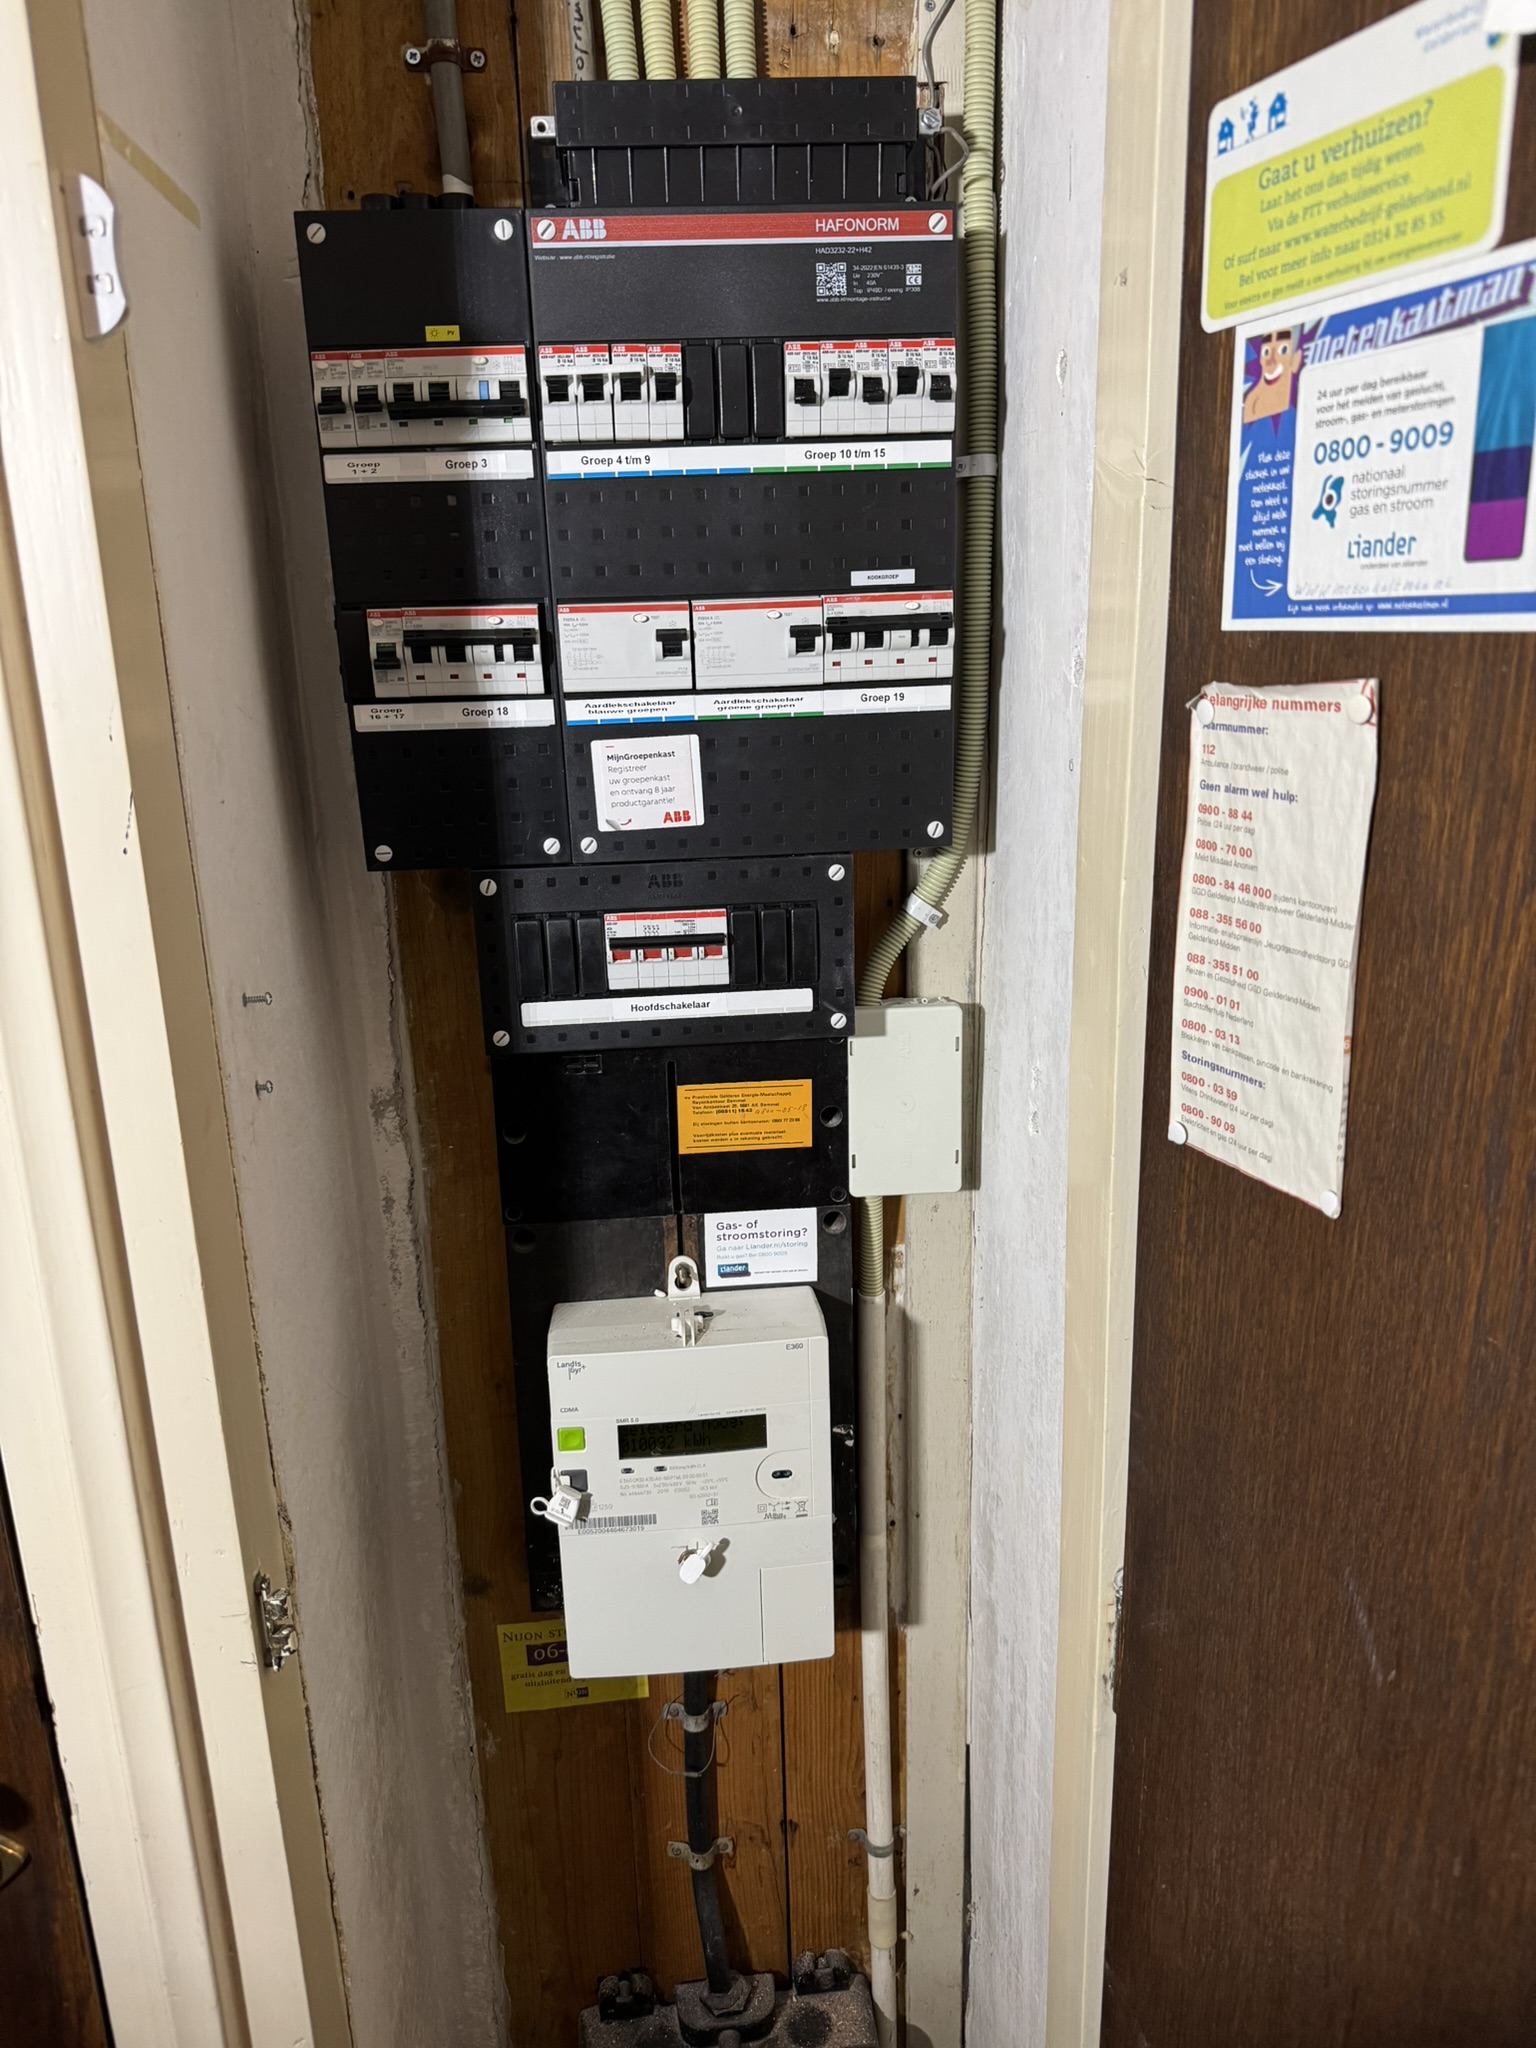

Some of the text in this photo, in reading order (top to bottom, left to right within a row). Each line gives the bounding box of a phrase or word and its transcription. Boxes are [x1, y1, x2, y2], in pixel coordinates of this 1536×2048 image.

[1259, 97, 1434, 190] Gaat u verhuizen?
[1261, 196, 1282, 213] Laat
[1284, 188, 1302, 204] het
[1286, 211, 1300, 226] de
[1302, 202, 1323, 221] PTT
[562, 217, 900, 240] ABB HAFONORM
[1224, 253, 1236, 270] Of
[1237, 246, 1258, 266] surf
[1258, 242, 1282, 259] naar
[1239, 239, 1360, 288] Bel voor meer info naar
[1317, 390, 1328, 400] 24
[1329, 388, 1342, 398] uur
[1345, 385, 1359, 396] per
[1361, 379, 1377, 392] dag
[1316, 403, 1334, 414] voor
[1336, 400, 1350, 410] het
[1352, 394, 1383, 407] melden
[1351, 413, 1369, 425] gas-
[1371, 409, 1382, 419] en
[1314, 420, 1454, 465] 0800 9009
[581, 455, 650, 466] Groep 4 t/m 9
[805, 449, 886, 461] Groep 10 t/m 15
[446, 459, 488, 472] Groep 3
[1352, 465, 1405, 485] nationaal
[1350, 479, 1448, 501] storingsnummer
[1350, 498, 1434, 519] gas en stroom
[1347, 532, 1417, 559] Liander
[585, 700, 676, 708] Aardlekschakelaar
[713, 697, 804, 705] Aardlekschakelaar
[860, 693, 904, 704] Groep 19
[1272, 698, 1342, 713] nummers
[462, 707, 508, 718] Groep 18
[607, 750, 675, 762] MijnGroepenkast
[1202, 744, 1215, 755] 112
[608, 764, 647, 773] Registreer
[622, 774, 670, 785] groepenkast
[621, 787, 653, 795] ontvang
[661, 785, 675, 794] jaar
[1200, 780, 1298, 805] Geen alarm wel hulp:
[611, 796, 675, 808] productgarantie!
[663, 810, 691, 824] ABB
[1198, 803, 1253, 822] 0900 88 44
[1196, 838, 1253, 858] 0800 70 00
[648, 873, 683, 889] ABB
[1193, 873, 1272, 899] 0800 84 46 000
[1189, 907, 1262, 934] 088 355 56 00
[1187, 952, 1259, 981] 088 355 51 00
[630, 1000, 711, 1012] Hoofdschakelaar
[1184, 986, 1240, 1011] 0900 01 01
[1181, 1018, 1240, 1046] 0800 03 13
[1181, 1050, 1266, 1090] Storingsnummers:
[1181, 1071, 1238, 1101] 0800 03 59
[1181, 1103, 1236, 1134] 0800 90 09
[716, 1220, 758, 1230] Gas- of
[717, 1228, 808, 1241] stroomstoring?
[746, 1242, 808, 1250] Liander.nl/storing
[720, 1265, 746, 1273] Liander
[684, 1433, 711, 1448] kWh
[503, 1629, 566, 1643] NUON ST
[511, 1671, 535, 1680] gratis
[538, 1670, 553, 1678] dag
[525, 1677, 572, 1687] uitsluitend
